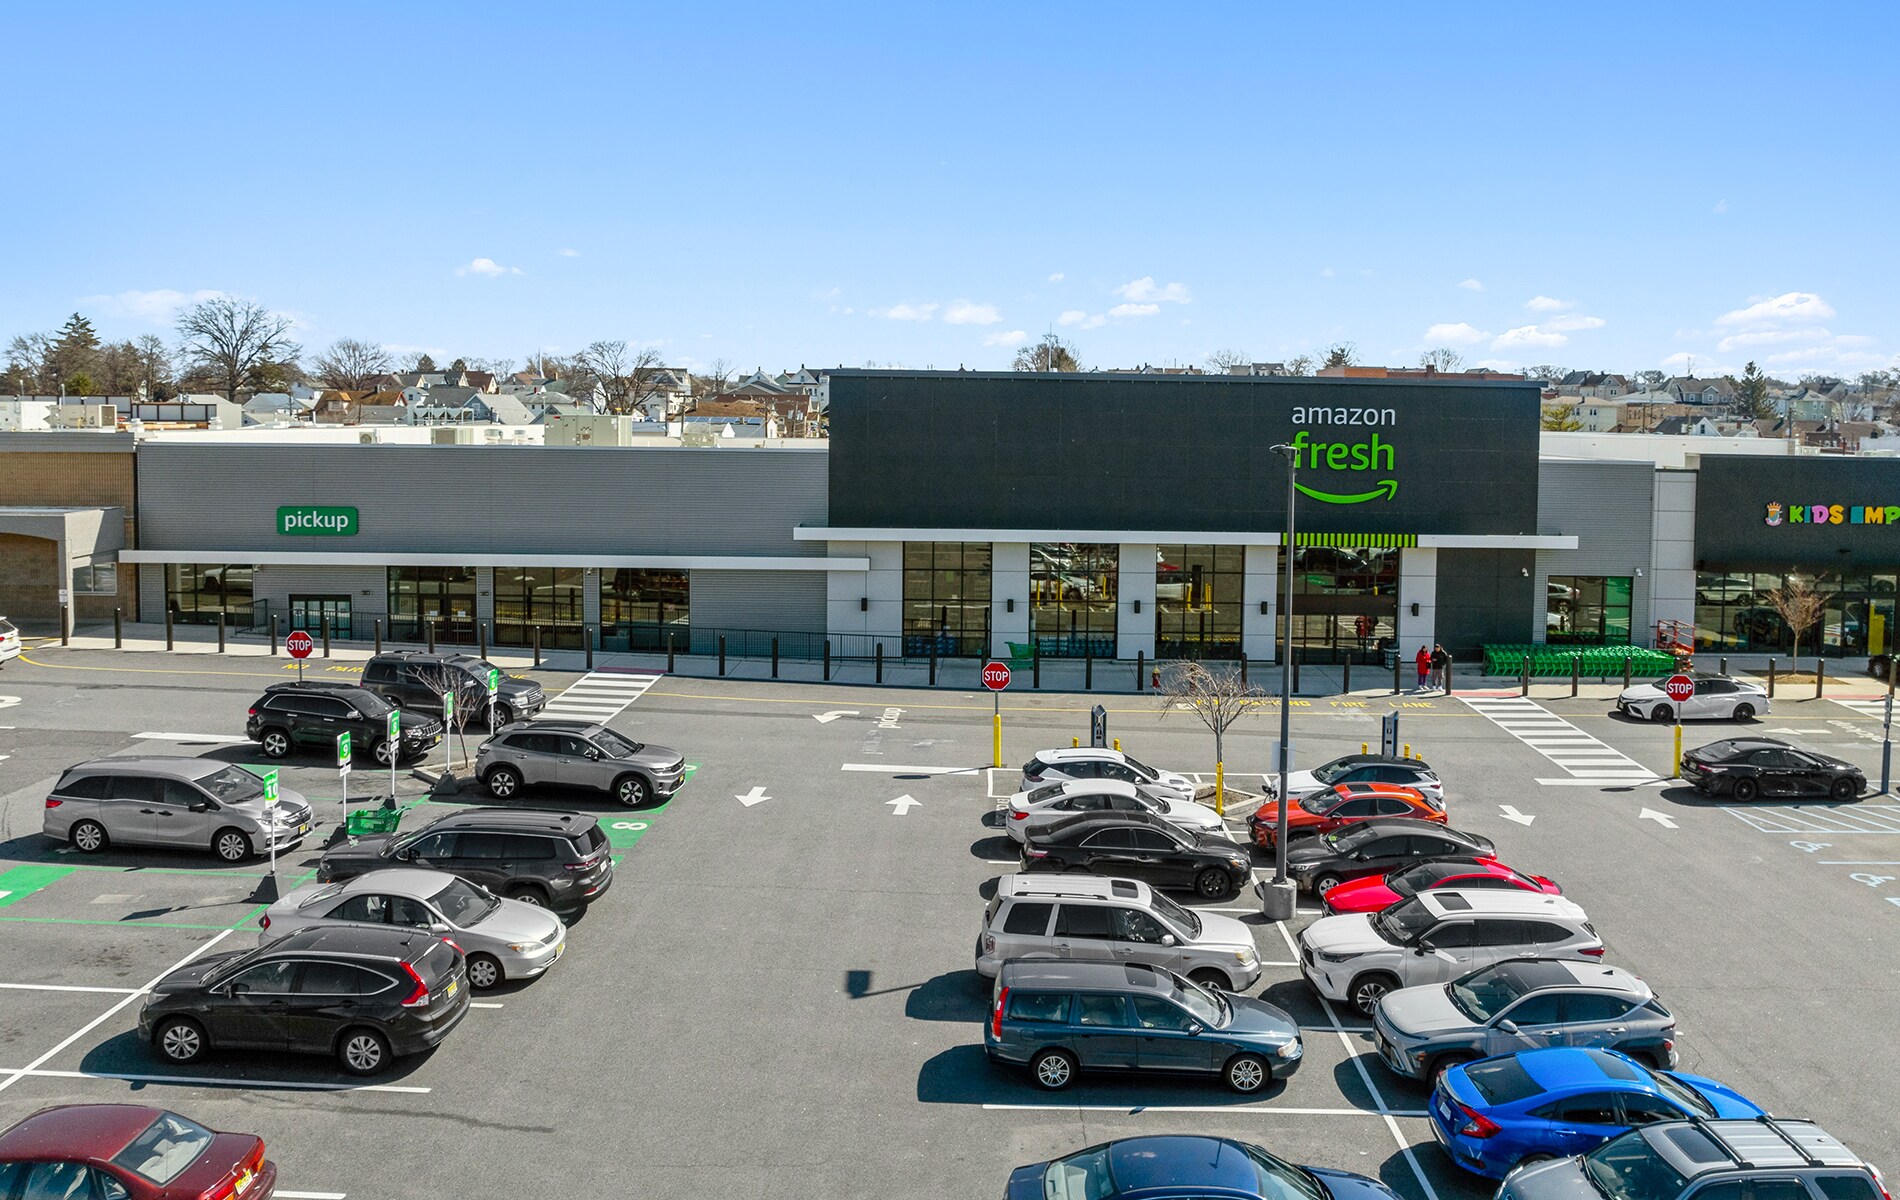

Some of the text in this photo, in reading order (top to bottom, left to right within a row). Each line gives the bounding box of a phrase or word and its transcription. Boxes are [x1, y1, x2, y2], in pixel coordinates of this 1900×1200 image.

[1291, 406, 1396, 426] amazon
[1291, 431, 1395, 471] fresh
[284, 510, 349, 532] pickup
[1789, 504, 1845, 525] KIDS
[288, 639, 311, 651] STOP
[984, 670, 1008, 682] STOP
[1667, 683, 1693, 694] STOP
[343, 743, 349, 756] 9
[265, 782, 279, 798] 10
